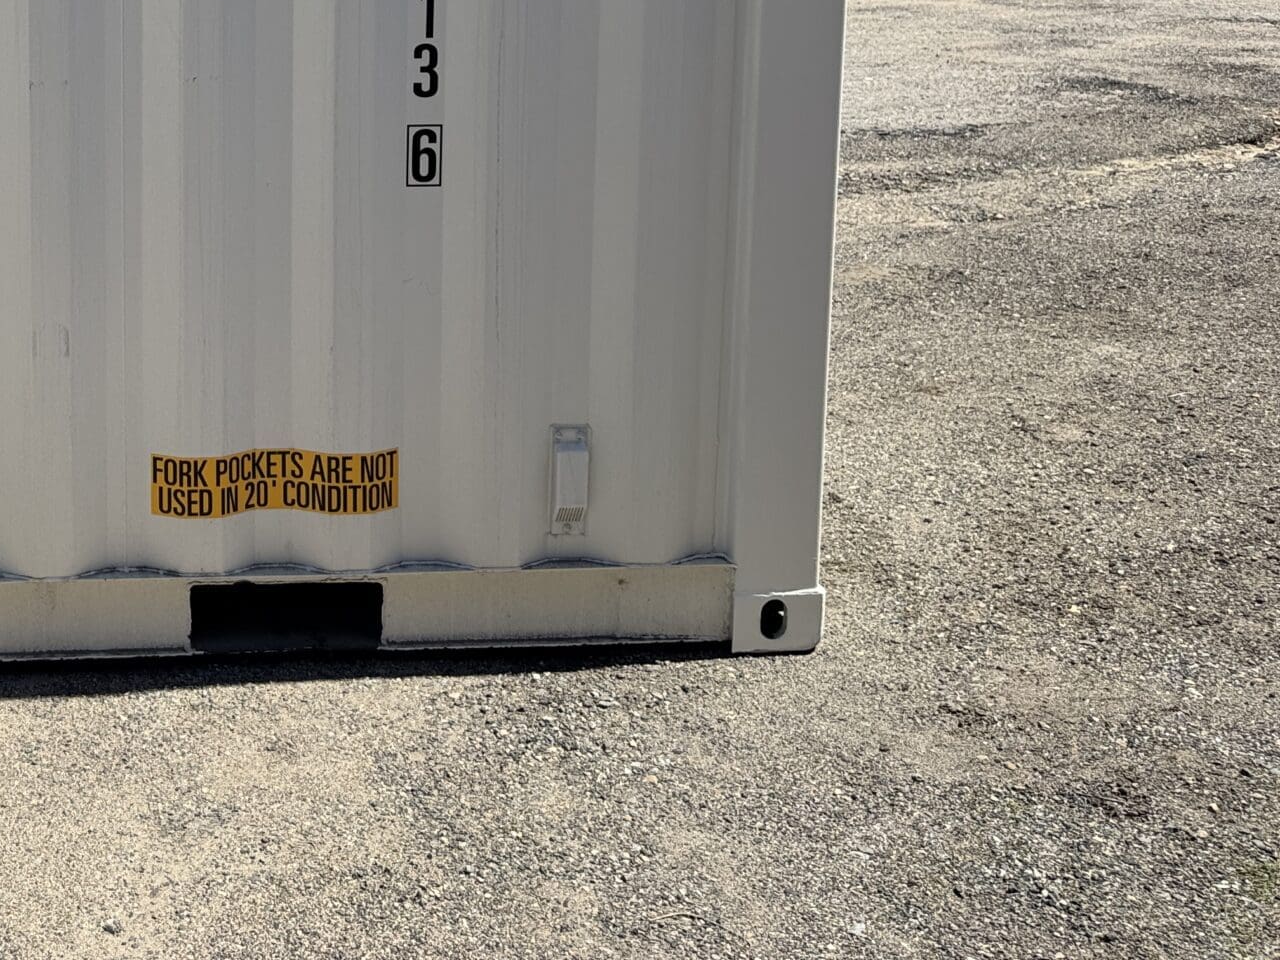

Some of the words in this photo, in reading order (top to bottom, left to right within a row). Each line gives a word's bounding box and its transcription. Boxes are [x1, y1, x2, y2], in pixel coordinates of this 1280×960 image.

[411, 128, 437, 183] 6
[151, 456, 207, 487] FORK
[215, 451, 303, 487] POCKETS
[310, 454, 353, 483] ARE
[360, 450, 397, 483] NOT
[158, 486, 213, 517] USED
[221, 485, 238, 515] IN
[245, 480, 276, 509] 20'
[282, 480, 393, 513] CONDITION
